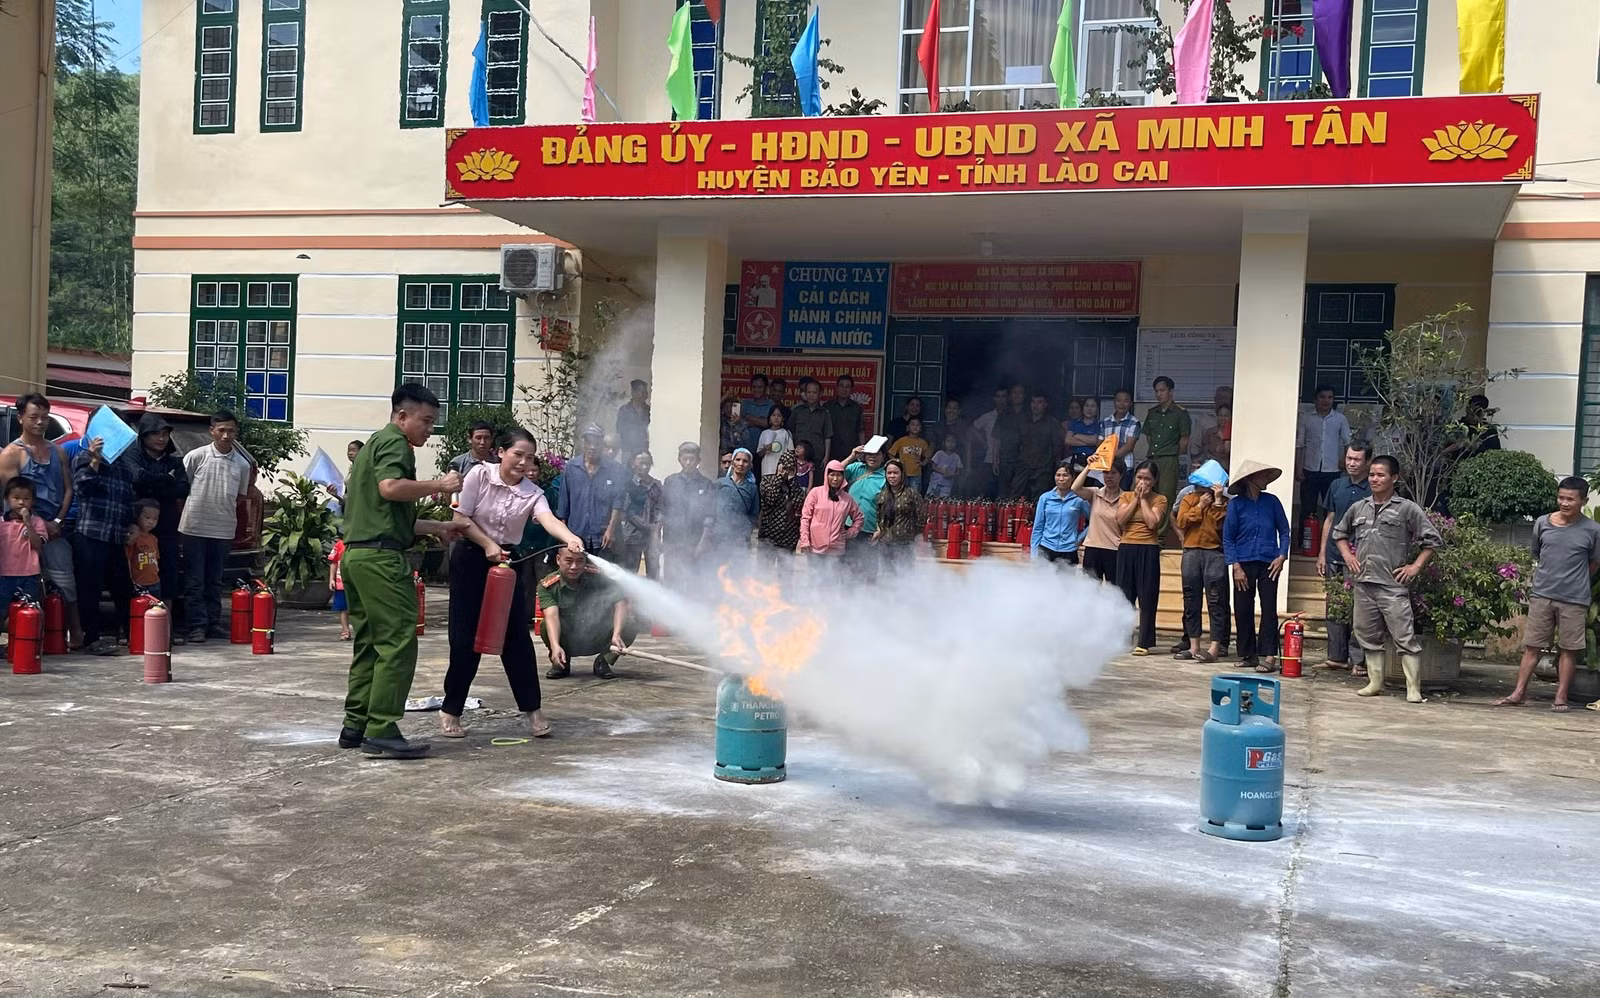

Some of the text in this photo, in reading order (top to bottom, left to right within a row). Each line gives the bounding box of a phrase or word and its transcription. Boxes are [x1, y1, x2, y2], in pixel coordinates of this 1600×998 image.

[541, 105, 1388, 164] ĐẢNG ỦY - HĐND - UBND XÃ MINH TÂN
[697, 164, 790, 192] HUYỆN
[800, 160, 859, 187] BẢO
[870, 161, 928, 186] YÊN
[956, 157, 1026, 184] TỈNH
[1038, 156, 1099, 183] LÀO
[1113, 161, 1169, 182] CAI
[788, 267, 887, 283] CHUNG TAY
[799, 285, 870, 305] CẢI CÁCH
[788, 306, 882, 325] HÀNH CHÍNH
[794, 327, 873, 346] NHÀ NƯỚC
[733, 363, 750, 377] VIỆC
[752, 365, 770, 375] THEO
[772, 364, 791, 376] HIẾN
[793, 364, 814, 377] PHÁP
[816, 365, 826, 377] VÀ
[828, 365, 849, 377] PHÁP
[851, 366, 871, 380] LUẬT
